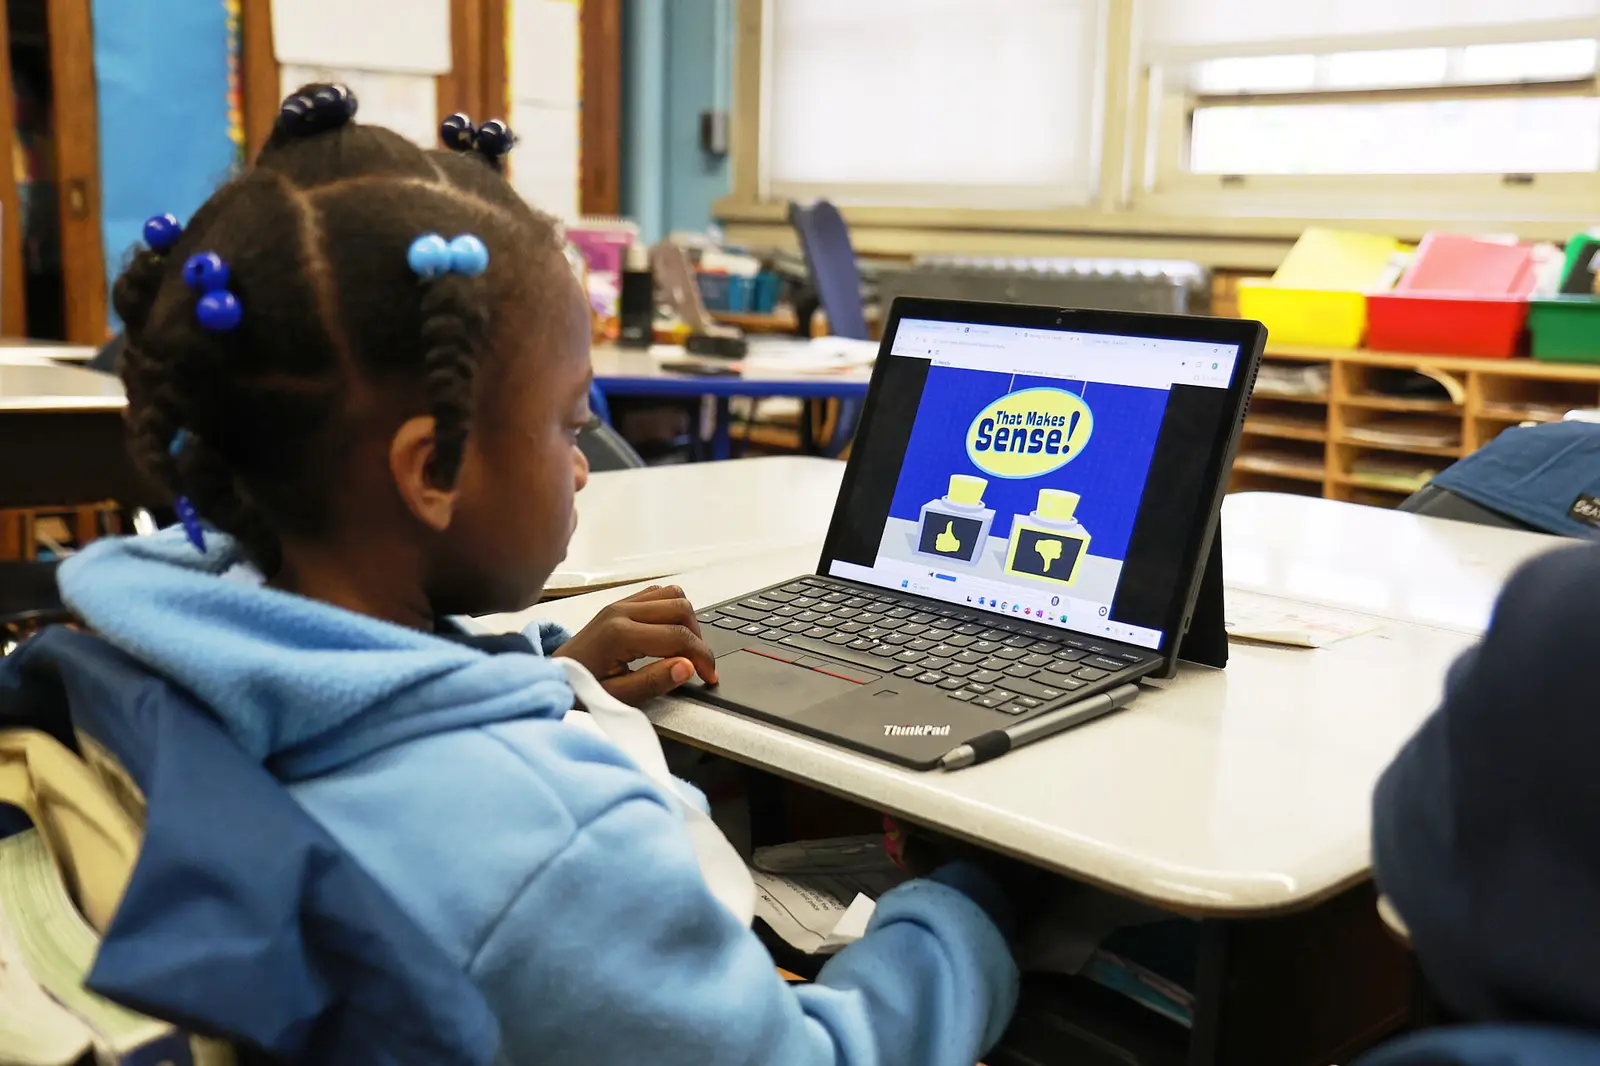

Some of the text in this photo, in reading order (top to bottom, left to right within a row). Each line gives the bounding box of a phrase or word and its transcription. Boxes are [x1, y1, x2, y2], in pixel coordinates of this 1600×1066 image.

[996, 410, 1066, 426] That Makes
[975, 410, 1080, 454] Sense!
[884, 724, 951, 736] ThinkPad
